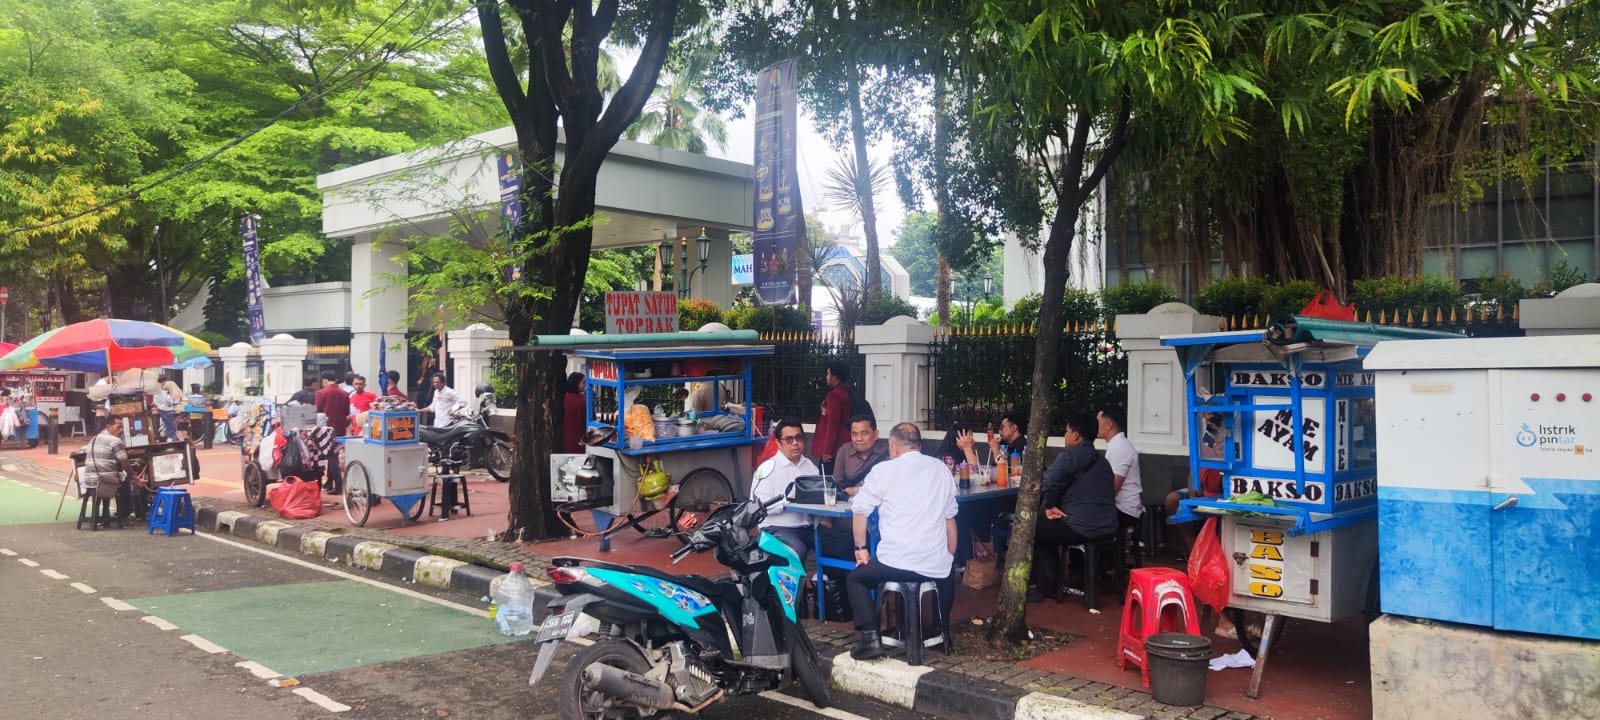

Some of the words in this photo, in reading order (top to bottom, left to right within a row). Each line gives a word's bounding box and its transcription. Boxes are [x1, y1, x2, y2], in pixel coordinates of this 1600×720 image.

[606, 293, 640, 316] TUPAT
[644, 293, 677, 315] SAYUR
[616, 317, 674, 333] TOPRAK
[589, 361, 618, 380] TOPRAK
[1336, 374, 1354, 385] MIE
[1276, 408, 1320, 438] ME
[1539, 424, 1576, 435] listrik
[1338, 400, 1346, 470] MIE
[1539, 436, 1576, 446] pintar
[1232, 477, 1323, 502] BAKSO
[1249, 529, 1285, 598] BASO
